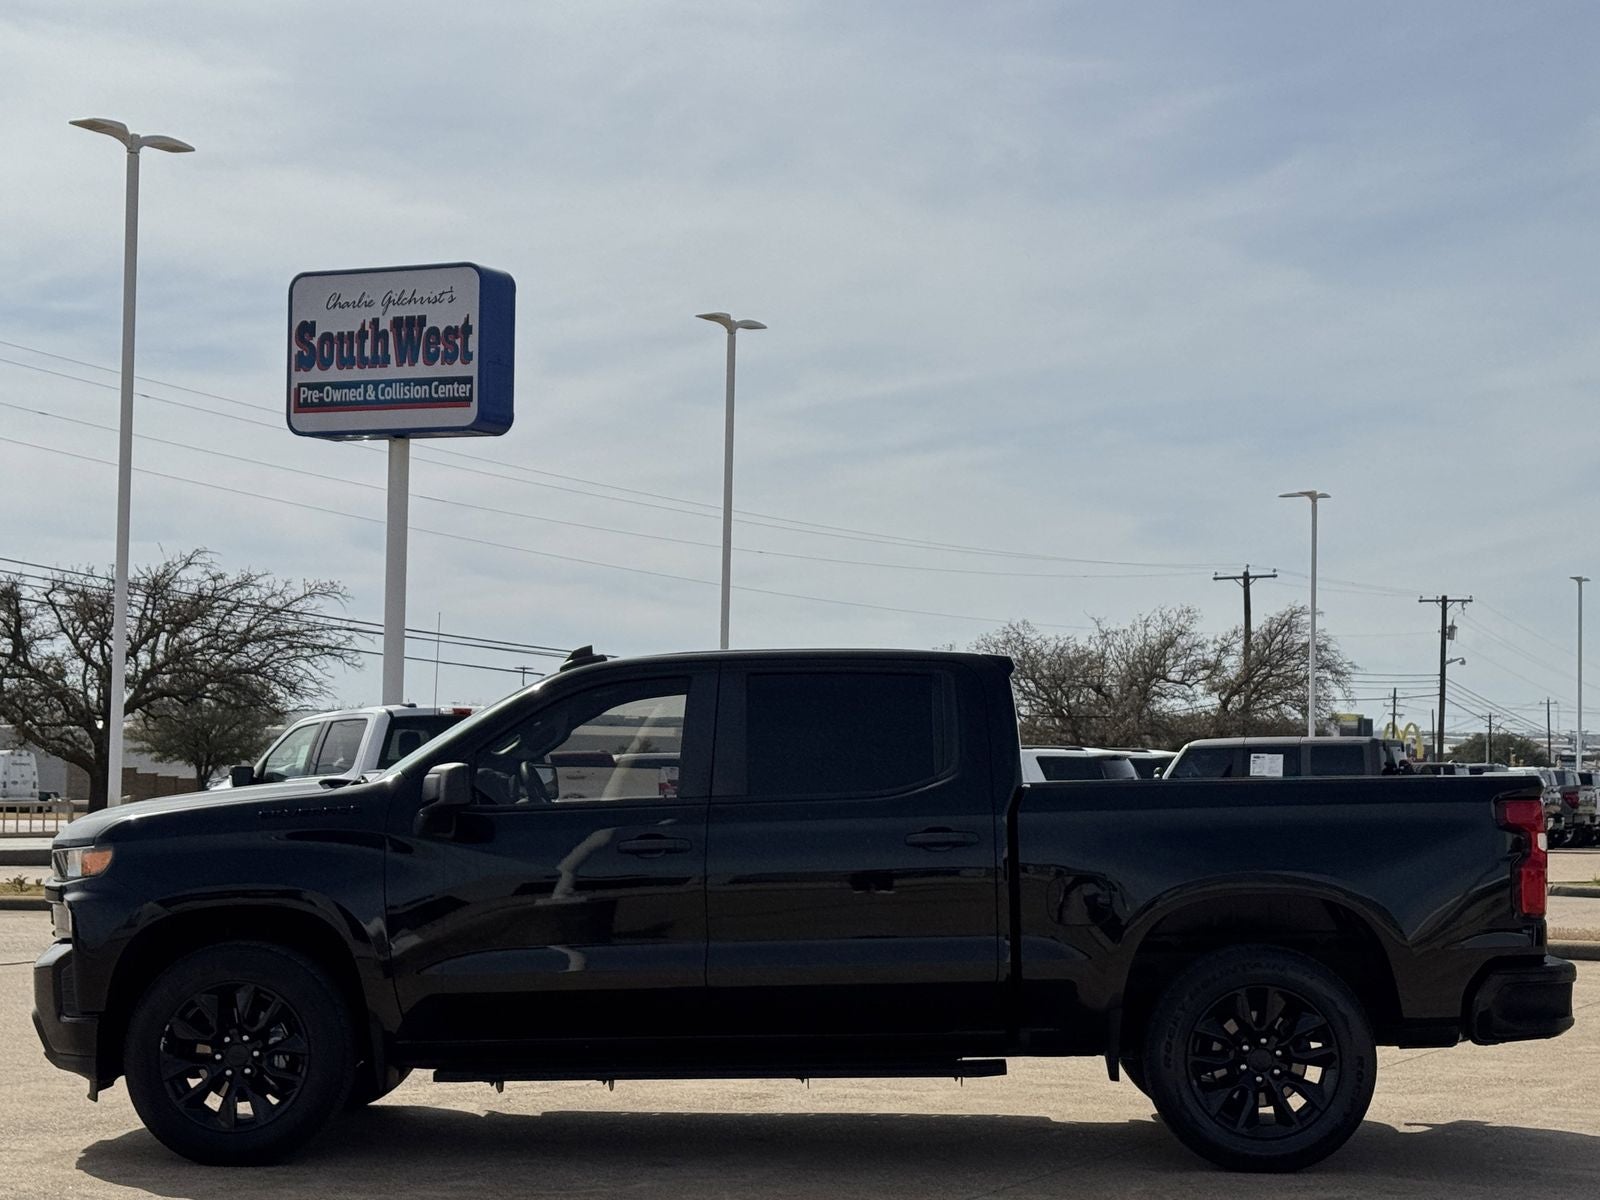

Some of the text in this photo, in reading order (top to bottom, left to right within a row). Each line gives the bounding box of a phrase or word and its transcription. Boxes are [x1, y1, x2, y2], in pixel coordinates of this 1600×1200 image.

[325, 285, 457, 317] Charlie Gilchrist's
[300, 381, 472, 404] Pre-Owned & Collision Center
